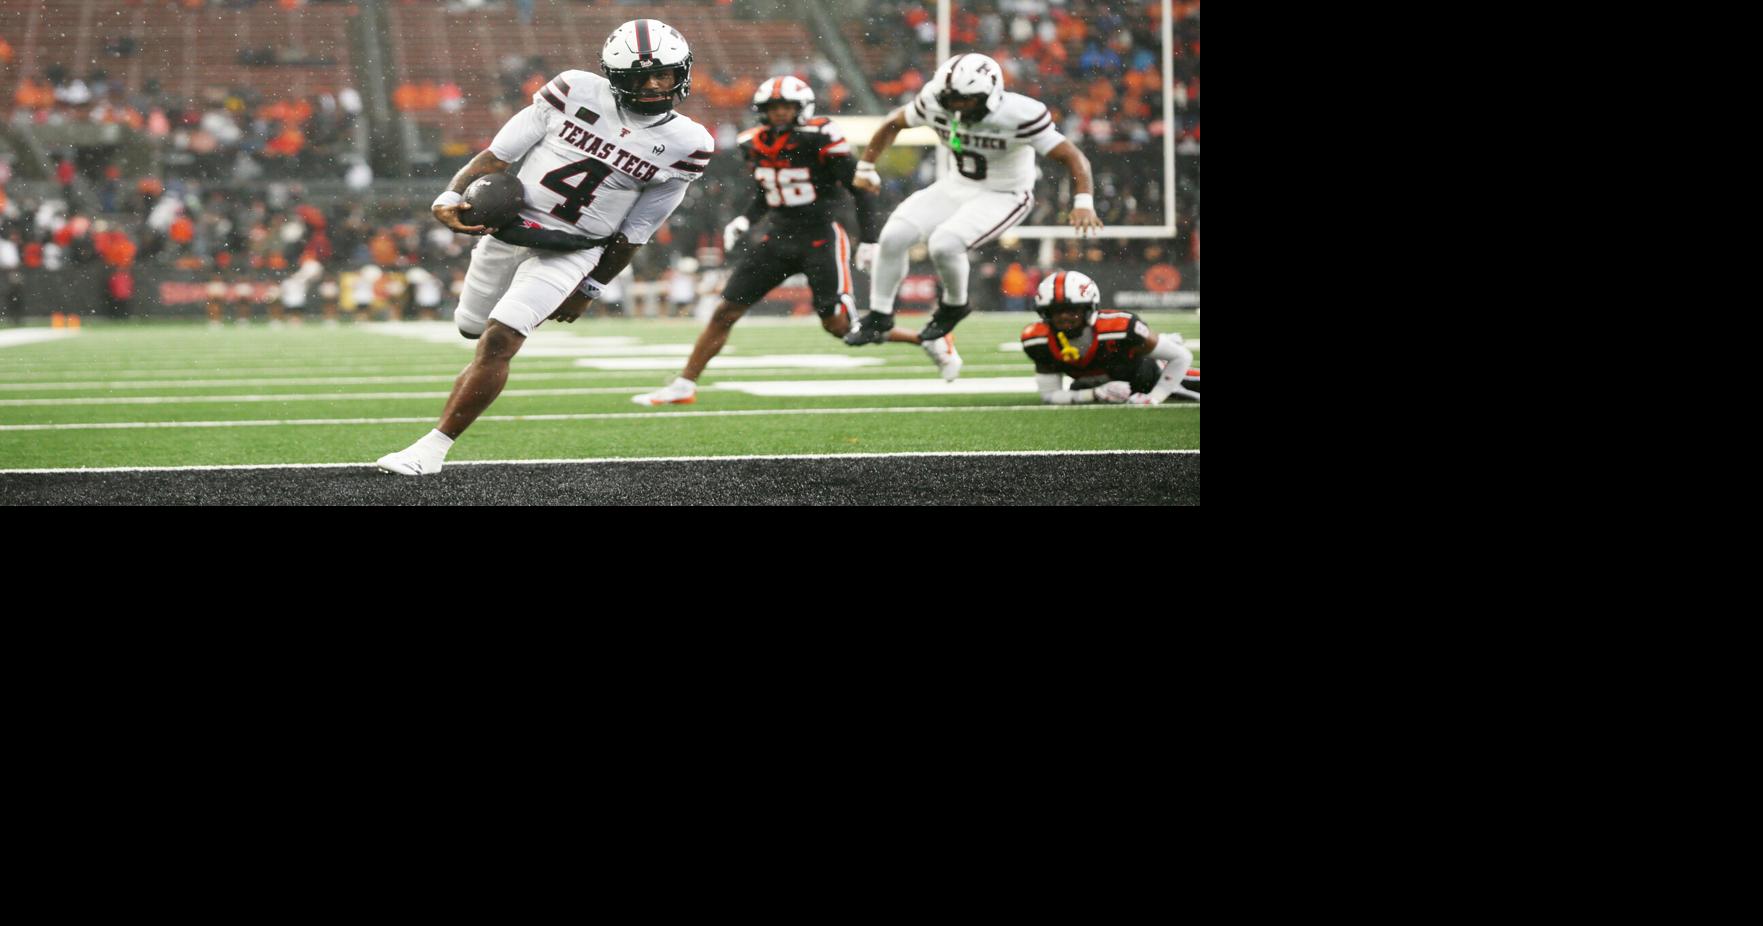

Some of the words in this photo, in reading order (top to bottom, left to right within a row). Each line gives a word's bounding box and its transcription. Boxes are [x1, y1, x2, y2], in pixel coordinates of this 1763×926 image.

[558, 120, 616, 160] TEXAS
[612, 149, 660, 182] TECH
[973, 135, 1007, 151] TECH
[953, 149, 988, 181] 0
[540, 157, 614, 225] 4
[754, 166, 817, 208] 36
